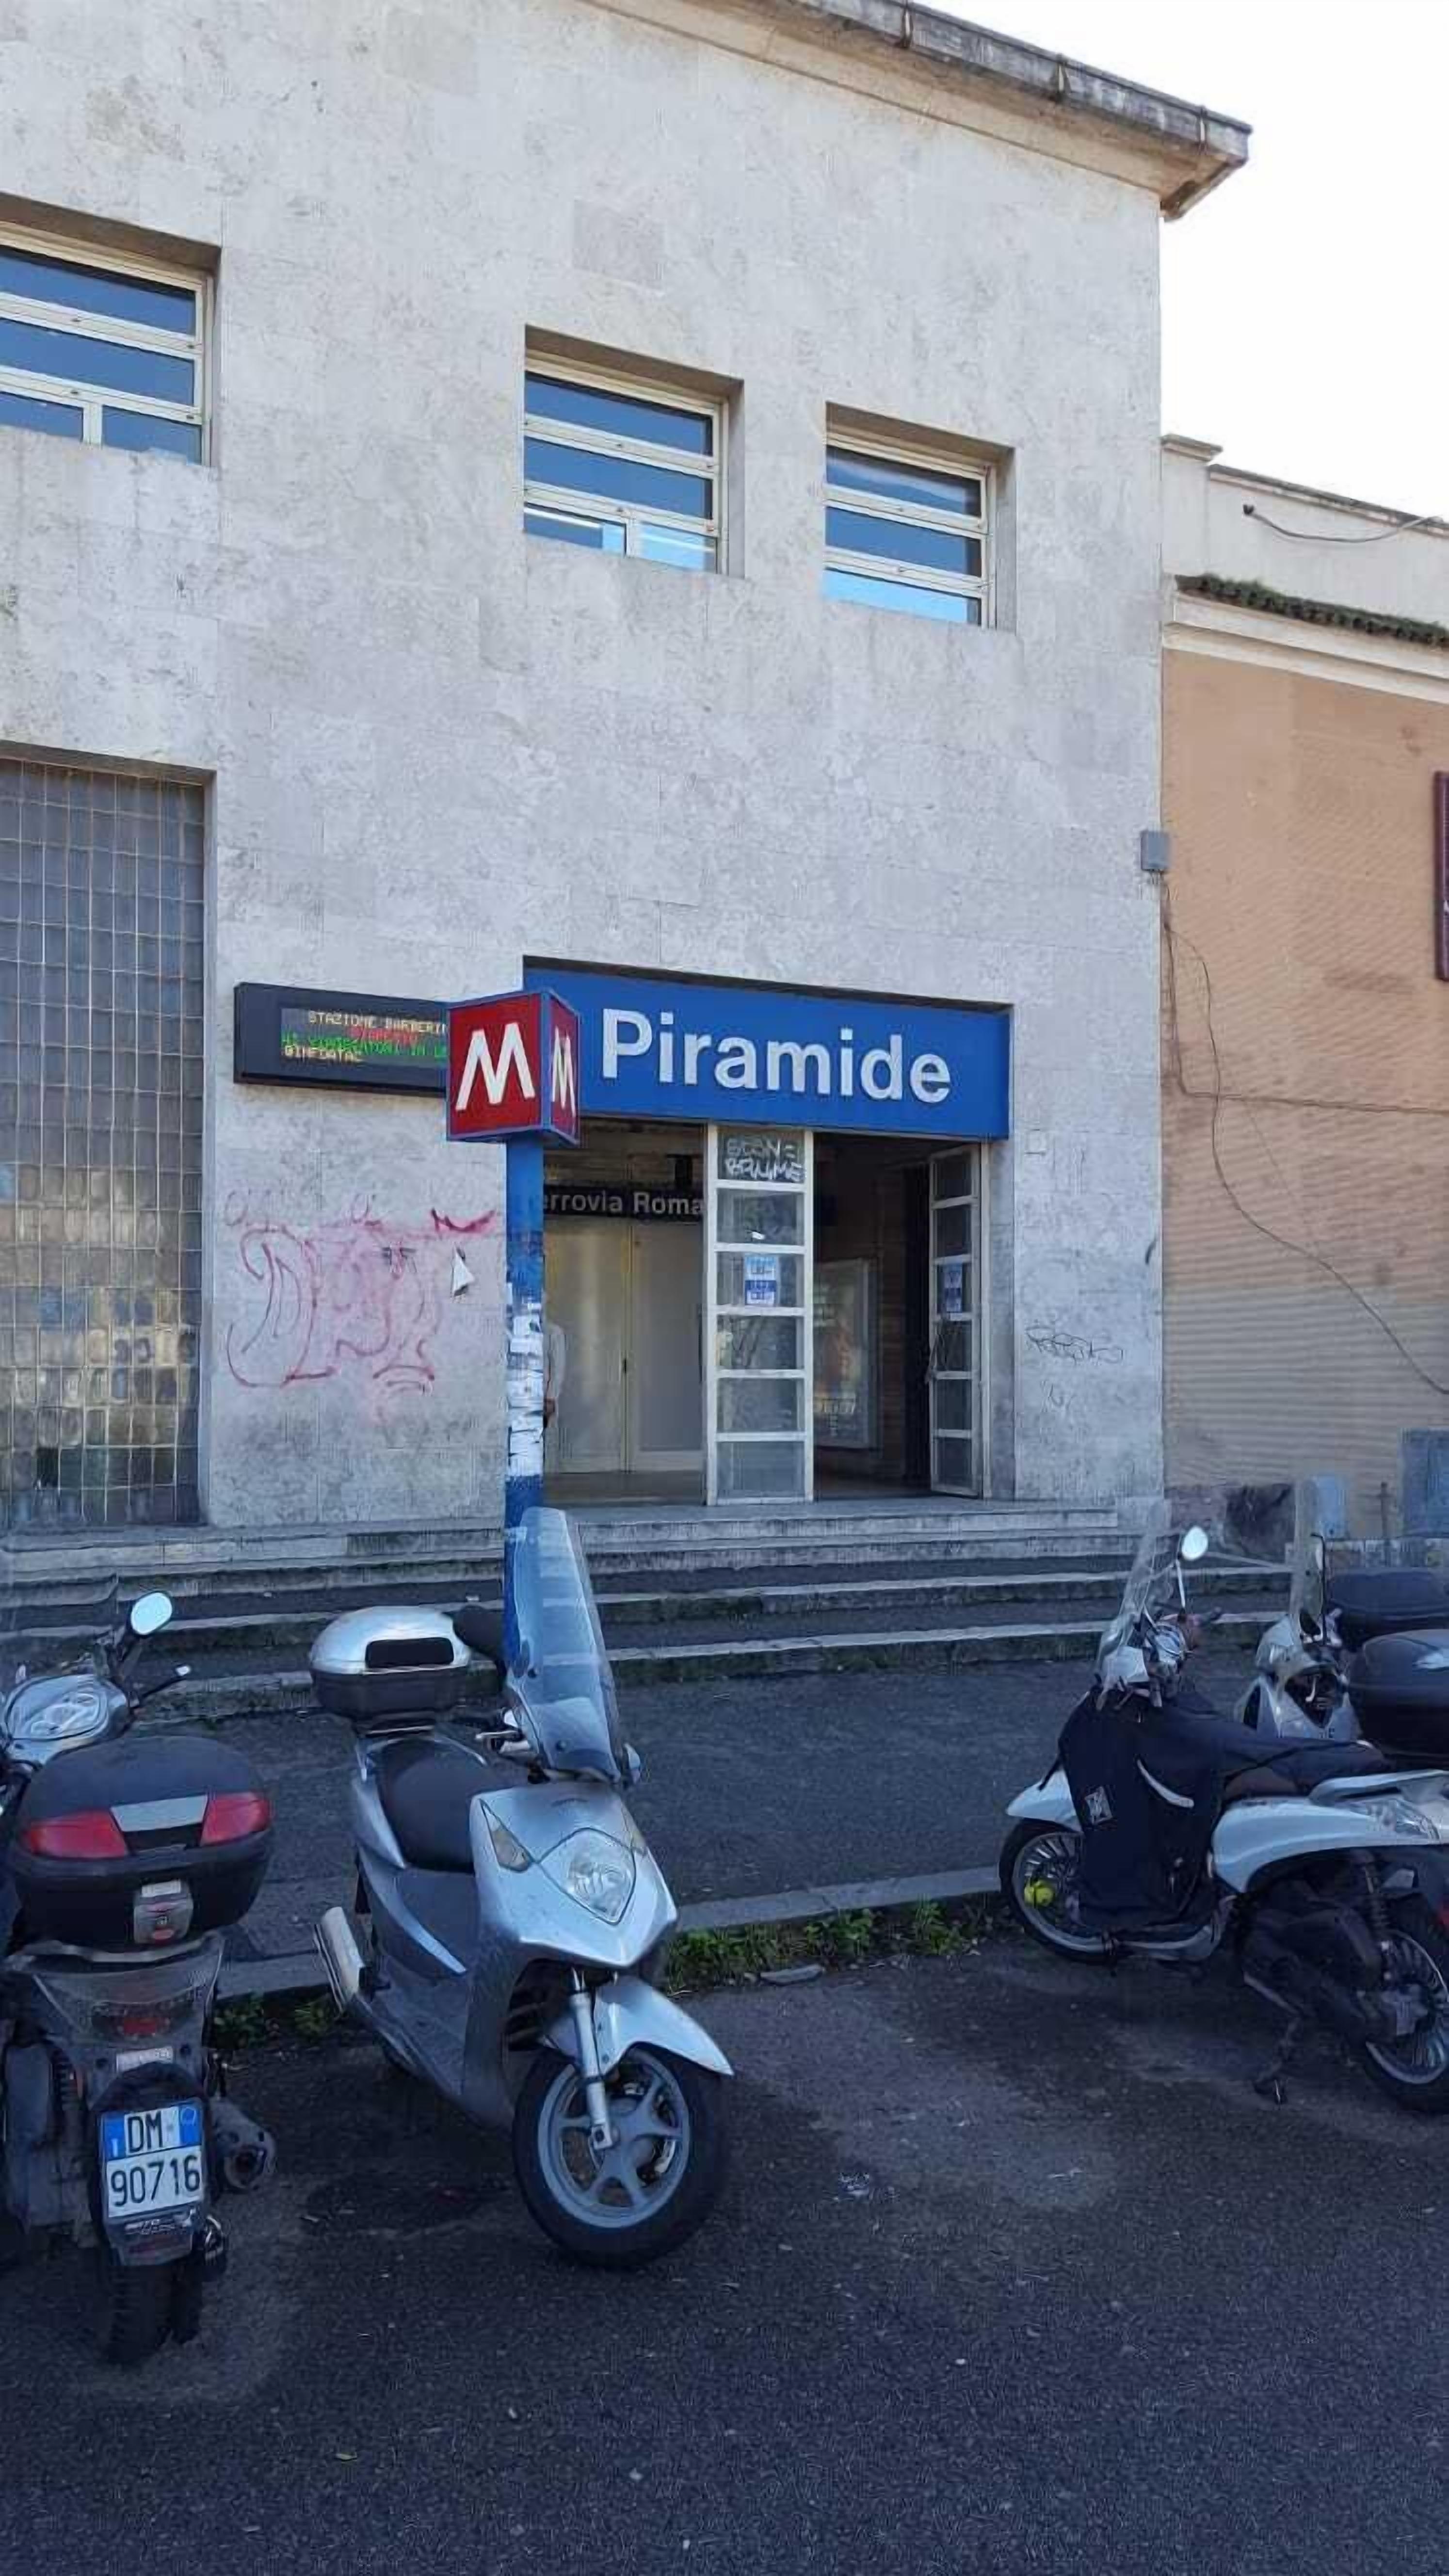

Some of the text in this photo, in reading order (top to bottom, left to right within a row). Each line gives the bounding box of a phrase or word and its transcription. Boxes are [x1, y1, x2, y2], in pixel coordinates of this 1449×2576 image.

[455, 1022, 535, 1111] M
[551, 1026, 576, 1117] M
[603, 1008, 951, 1103] Piramide
[127, 2110, 163, 2154] DM
[111, 2155, 200, 2207] 90716
